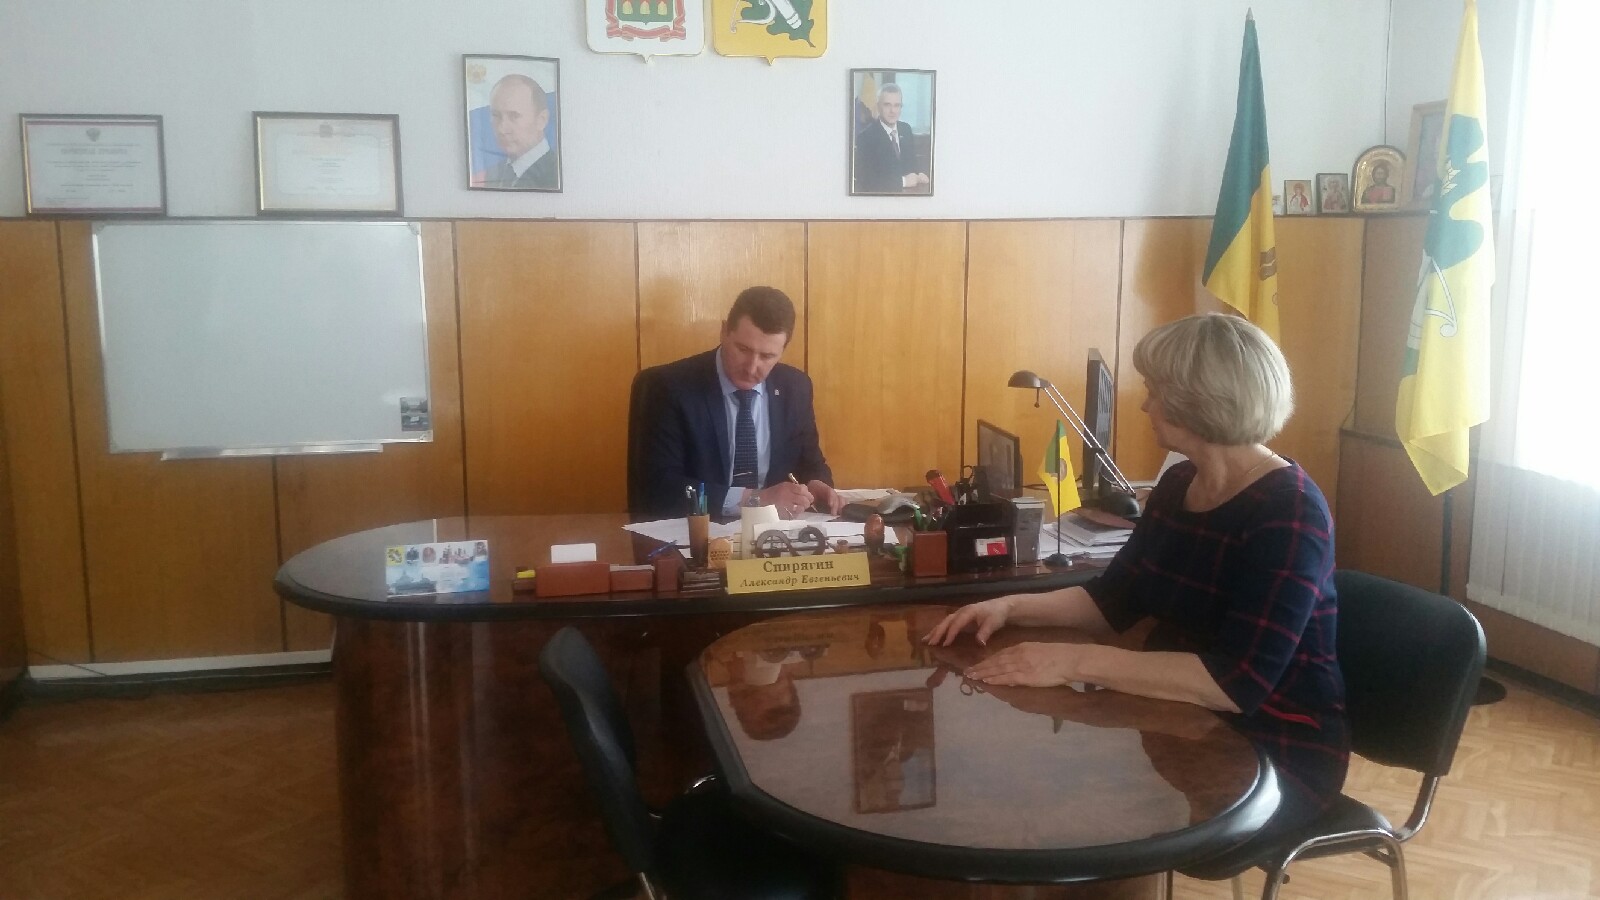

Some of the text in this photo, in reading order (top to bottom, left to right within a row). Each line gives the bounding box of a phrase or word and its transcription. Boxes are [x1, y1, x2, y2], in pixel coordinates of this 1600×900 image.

[763, 560, 834, 573] Спирягин
[740, 573, 860, 587] Александр Евгеньевич
